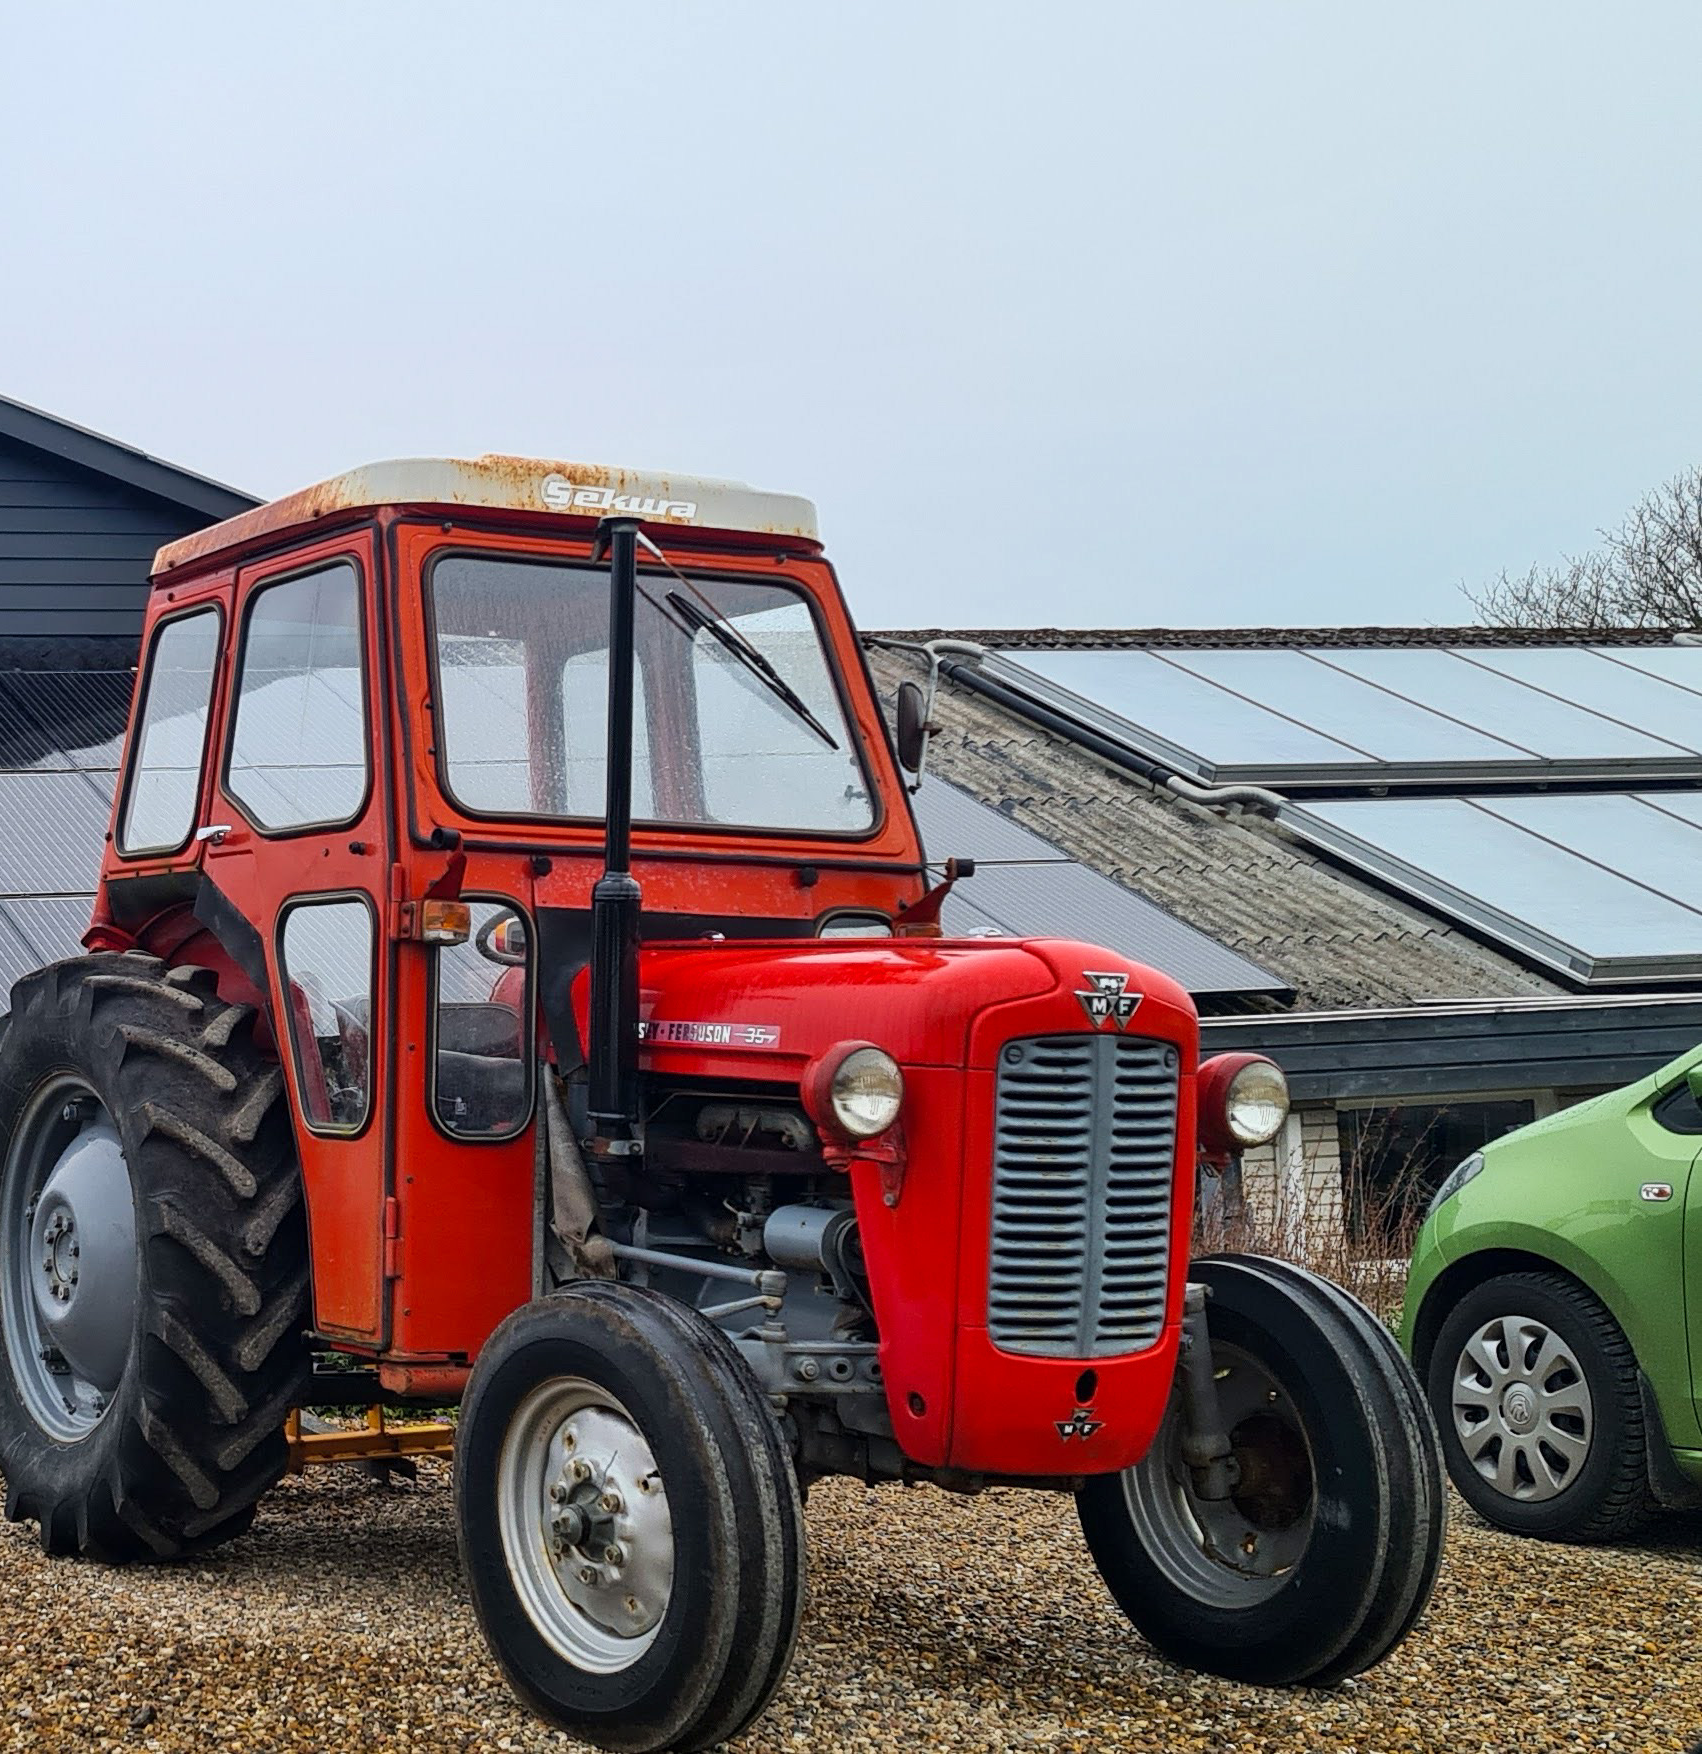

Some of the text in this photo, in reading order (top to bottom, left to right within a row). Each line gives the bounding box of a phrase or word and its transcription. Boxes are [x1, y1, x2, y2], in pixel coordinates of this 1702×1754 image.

[543, 481, 697, 518] Sekura
[668, 1023, 731, 1044] FERGUSON
[745, 1027, 766, 1044] 35
